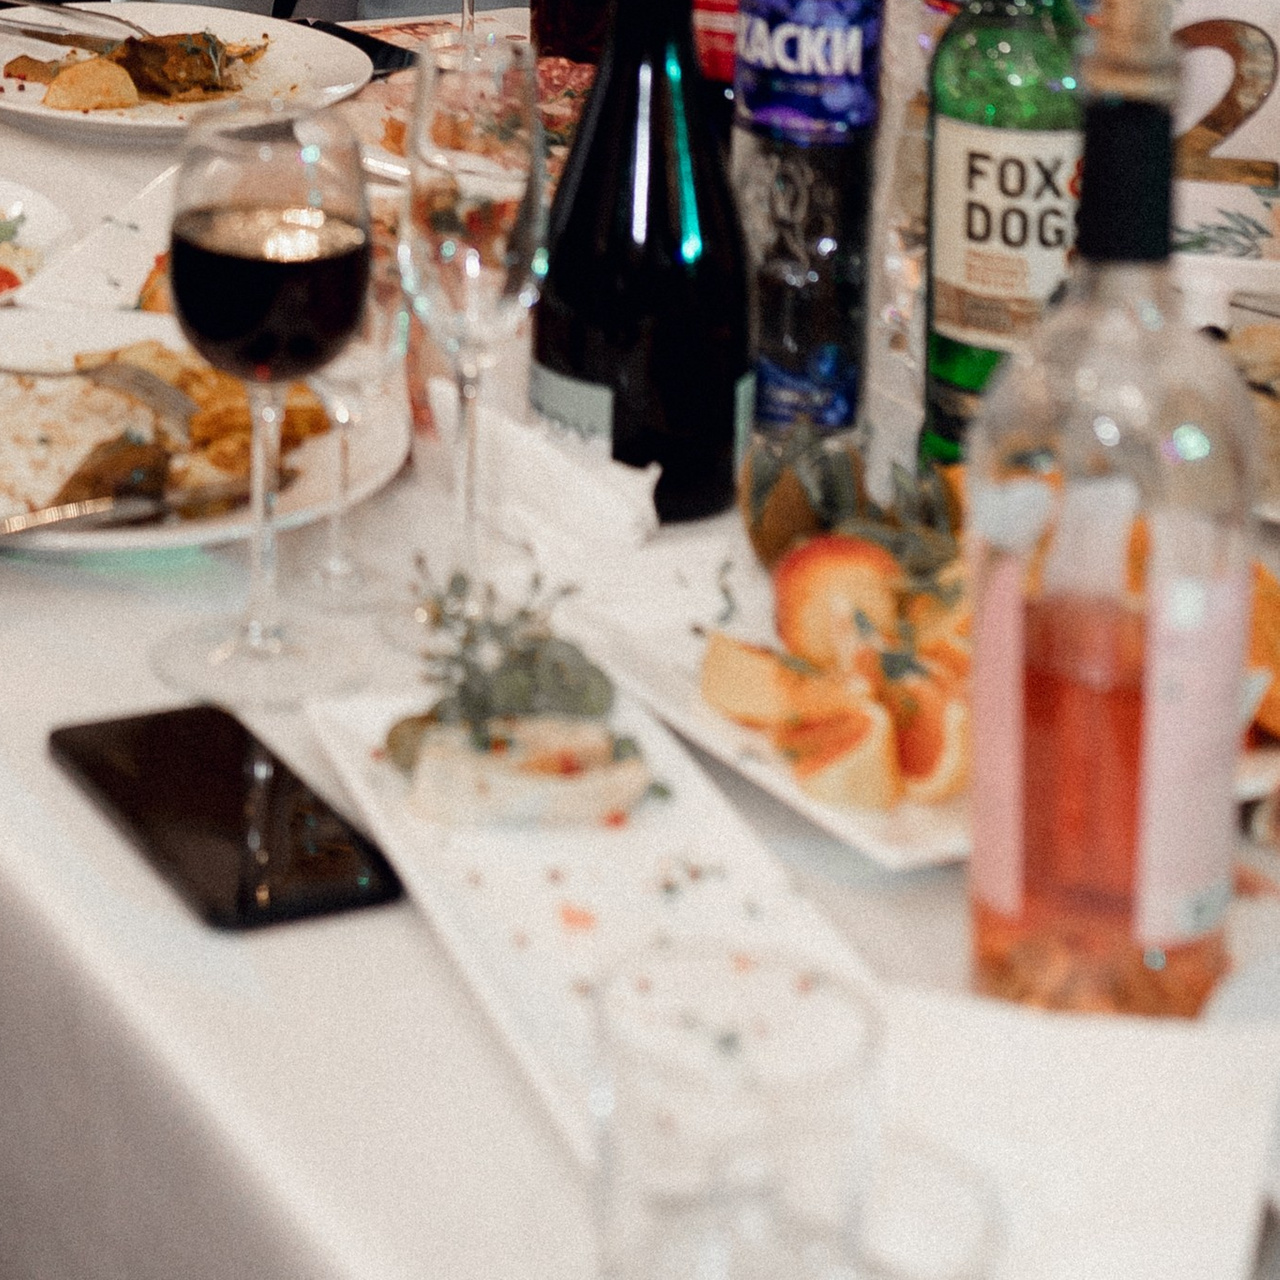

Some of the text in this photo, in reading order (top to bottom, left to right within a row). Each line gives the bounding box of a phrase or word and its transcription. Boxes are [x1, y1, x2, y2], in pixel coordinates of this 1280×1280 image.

[1172, 18, 1279, 187] 2
[967, 151, 1063, 199] FOX
[966, 201, 1066, 248] DOG
